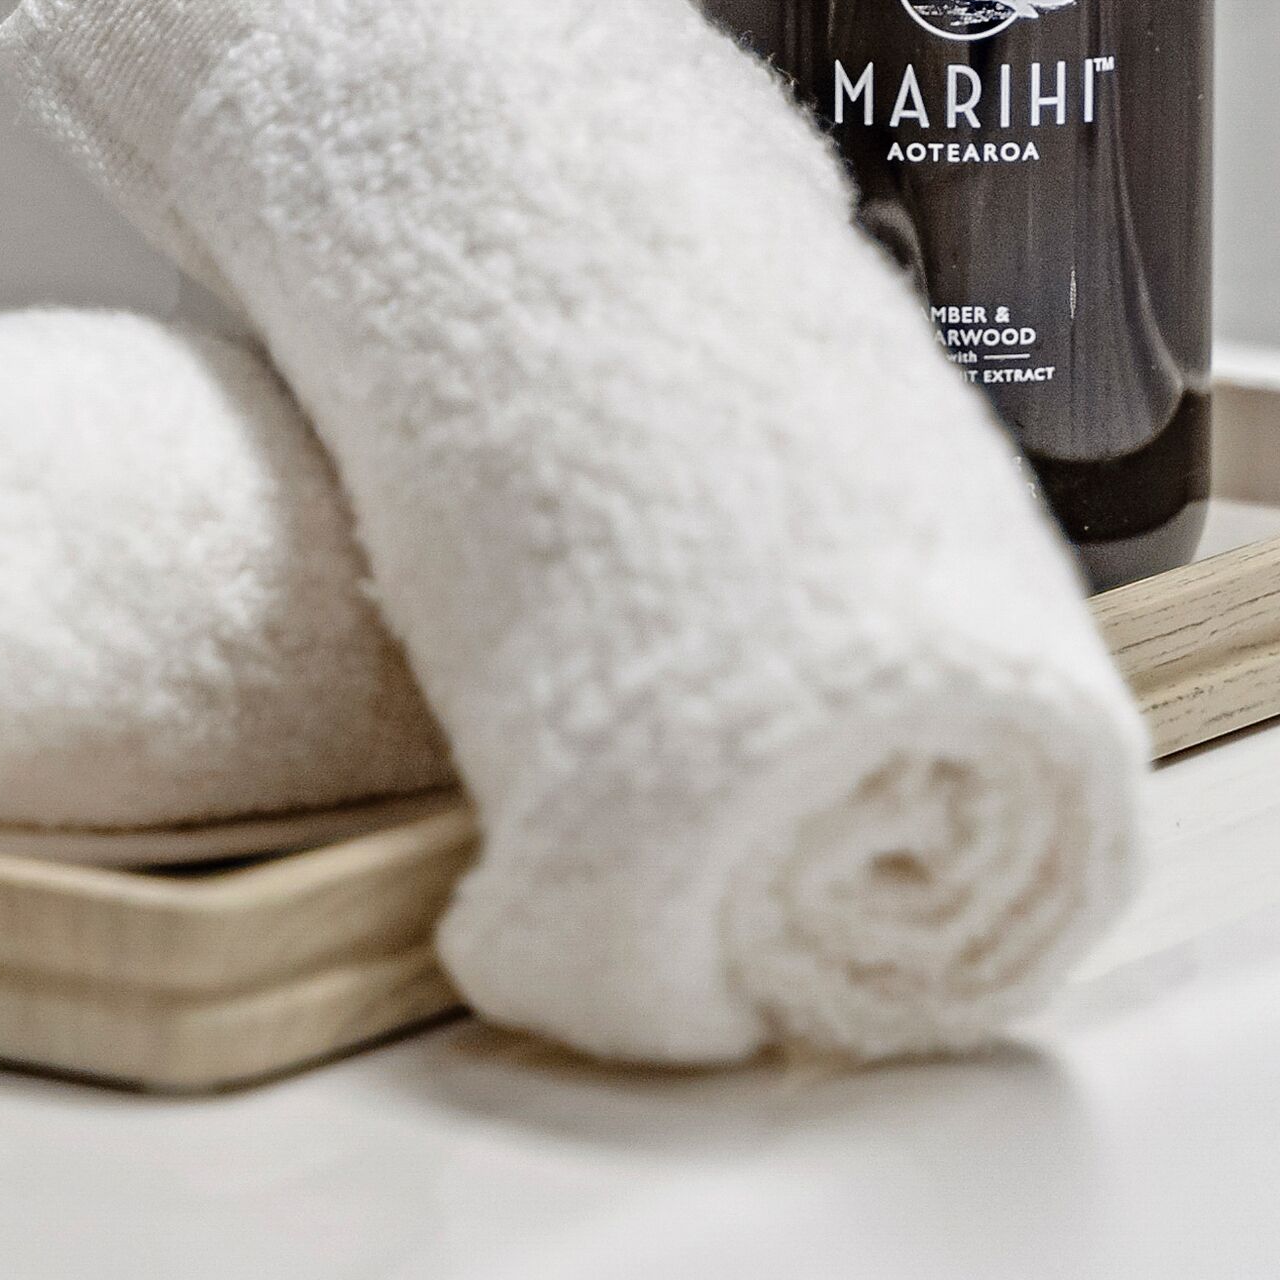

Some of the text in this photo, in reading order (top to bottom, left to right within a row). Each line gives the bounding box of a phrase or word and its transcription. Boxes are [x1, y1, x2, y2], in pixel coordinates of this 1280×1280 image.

[887, 141, 1040, 162] AOTEAROA
[994, 306, 1010, 323] &
[946, 350, 978, 363] with
[983, 366, 1056, 383] EXTRACT
